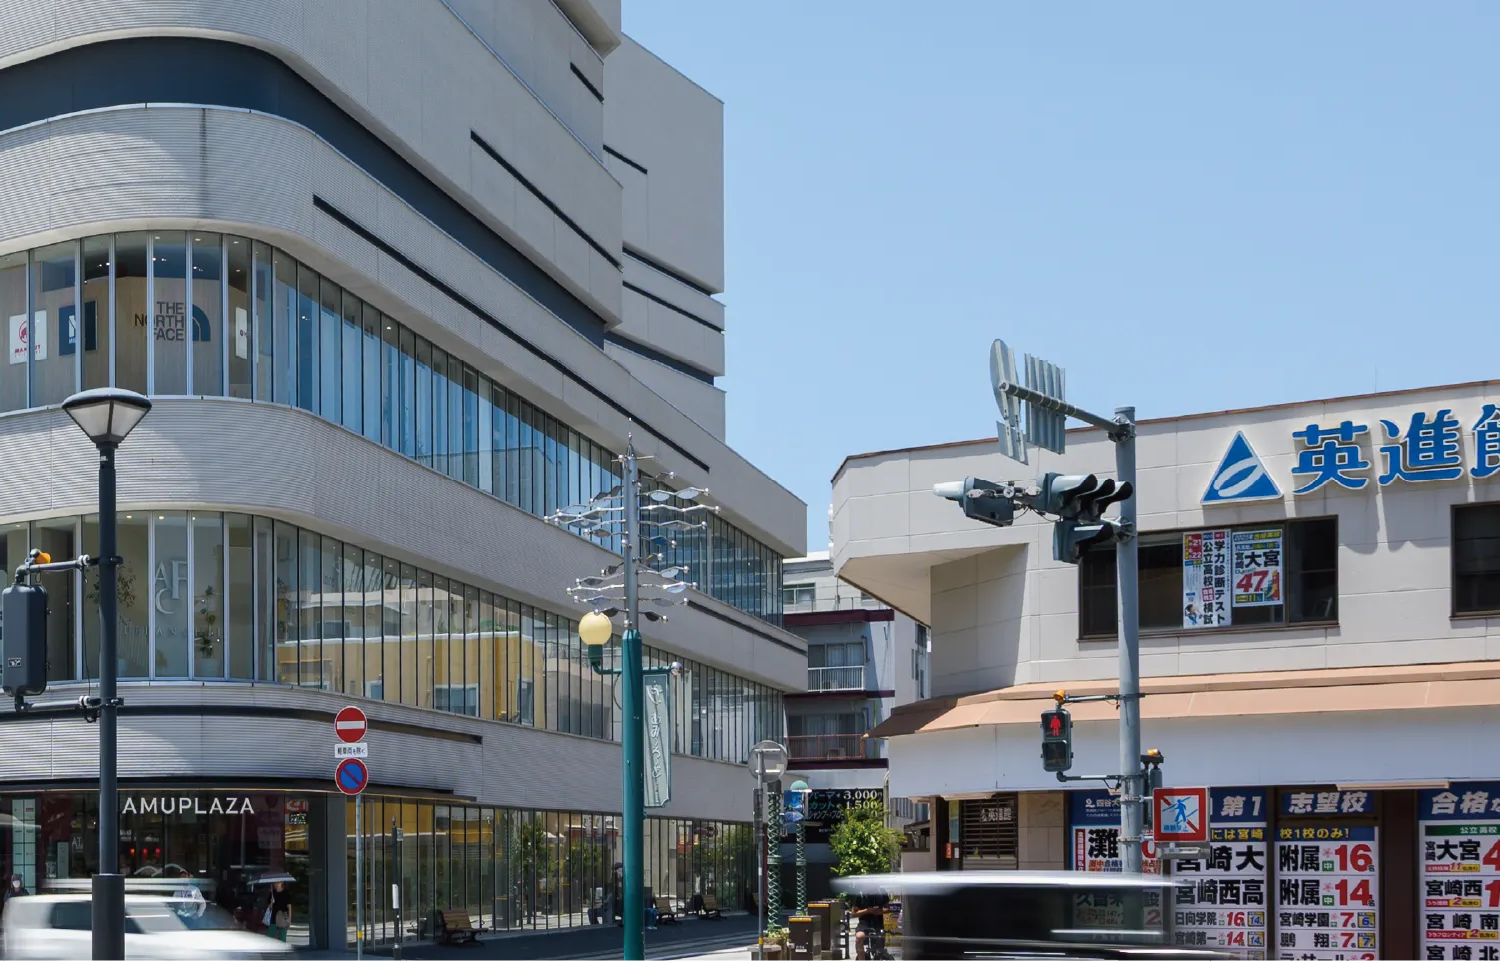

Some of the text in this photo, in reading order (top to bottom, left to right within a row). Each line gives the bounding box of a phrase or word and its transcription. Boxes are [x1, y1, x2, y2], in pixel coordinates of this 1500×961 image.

[156, 301, 184, 315] THE
[1203, 541, 1213, 587] 公立高校
[1245, 550, 1280, 569] 大宮
[1214, 540, 1225, 625] 学力診断テスト
[1203, 603, 1213, 625] 模試
[122, 797, 255, 815] AMUPLAZA
[809, 801, 835, 810] カット
[1288, 791, 1368, 814] 志望校
[1211, 828, 1264, 840] には宮崎
[1279, 844, 1320, 872] 附属
[1436, 839, 1481, 861] 大宮
[1175, 879, 1265, 905] 宮崎西高
[1279, 879, 1320, 906] 附属
[1425, 879, 1483, 897] 宮崎西
[1175, 911, 1217, 926] 日向学院
[1280, 912, 1330, 928] 宮崎学園
[1426, 912, 1500, 930] 宮崎南
[1175, 931, 1218, 946] 宮崎第一
[1426, 945, 1500, 961] 宮崎北
